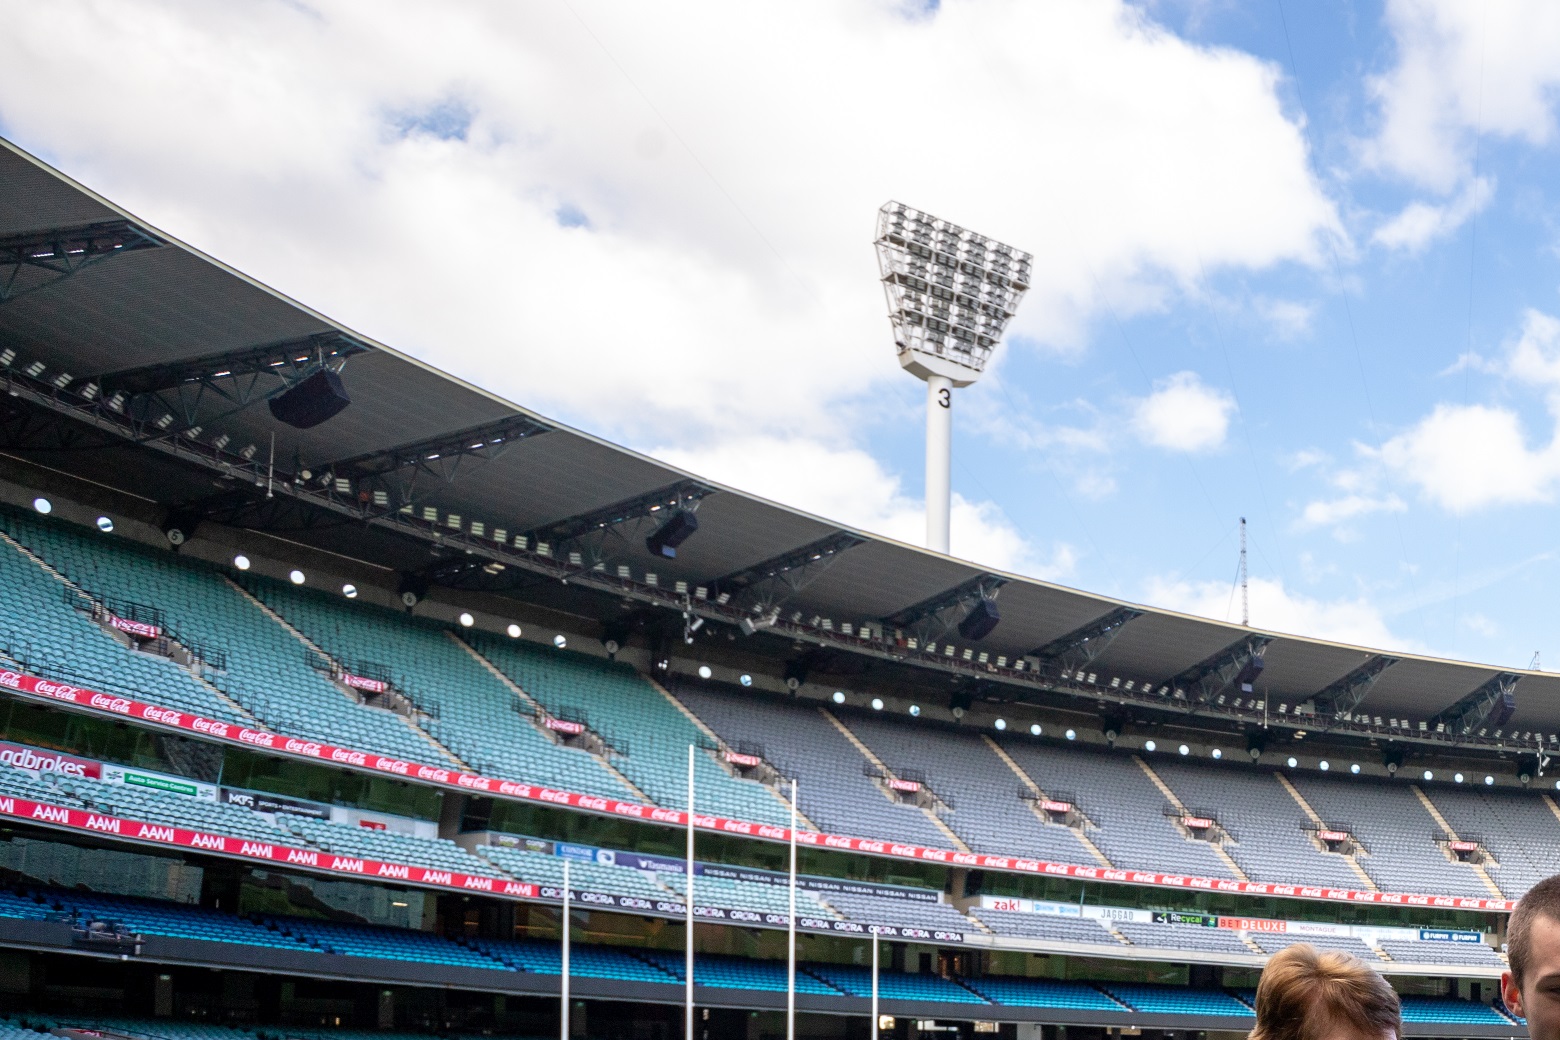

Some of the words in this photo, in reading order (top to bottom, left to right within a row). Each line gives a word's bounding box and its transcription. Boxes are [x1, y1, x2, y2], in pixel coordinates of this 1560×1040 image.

[938, 388, 951, 409] 3
[33, 806, 68, 822] AAMI
[86, 816, 119, 832] AAMI
[139, 826, 173, 841] AAMI
[191, 834, 224, 849] AAMI
[241, 843, 272, 857] AAMI
[288, 850, 317, 865] AAMI
[332, 858, 363, 872] AAMI
[379, 863, 408, 878] AAMI
[423, 868, 451, 884] AAMI
[465, 878, 491, 890] AAMI
[505, 883, 531, 895] AAMI
[648, 861, 683, 872] Tasmania
[704, 868, 737, 877] NISSAN
[740, 872, 771, 882] NISSAN
[774, 877, 806, 886] NISAN
[808, 881, 840, 890] NISSAN
[842, 885, 873, 894] NISSAN
[876, 889, 906, 898] NISSAN
[908, 892, 936, 901] NISSAN
[541, 888, 575, 900] OROA
[766, 914, 795, 925] OROR
[994, 900, 1020, 912] zak!
[1101, 908, 1134, 920] JAGGAD
[1170, 913, 1202, 924] Recycal
[1300, 926, 1336, 934] MONTAGUE
